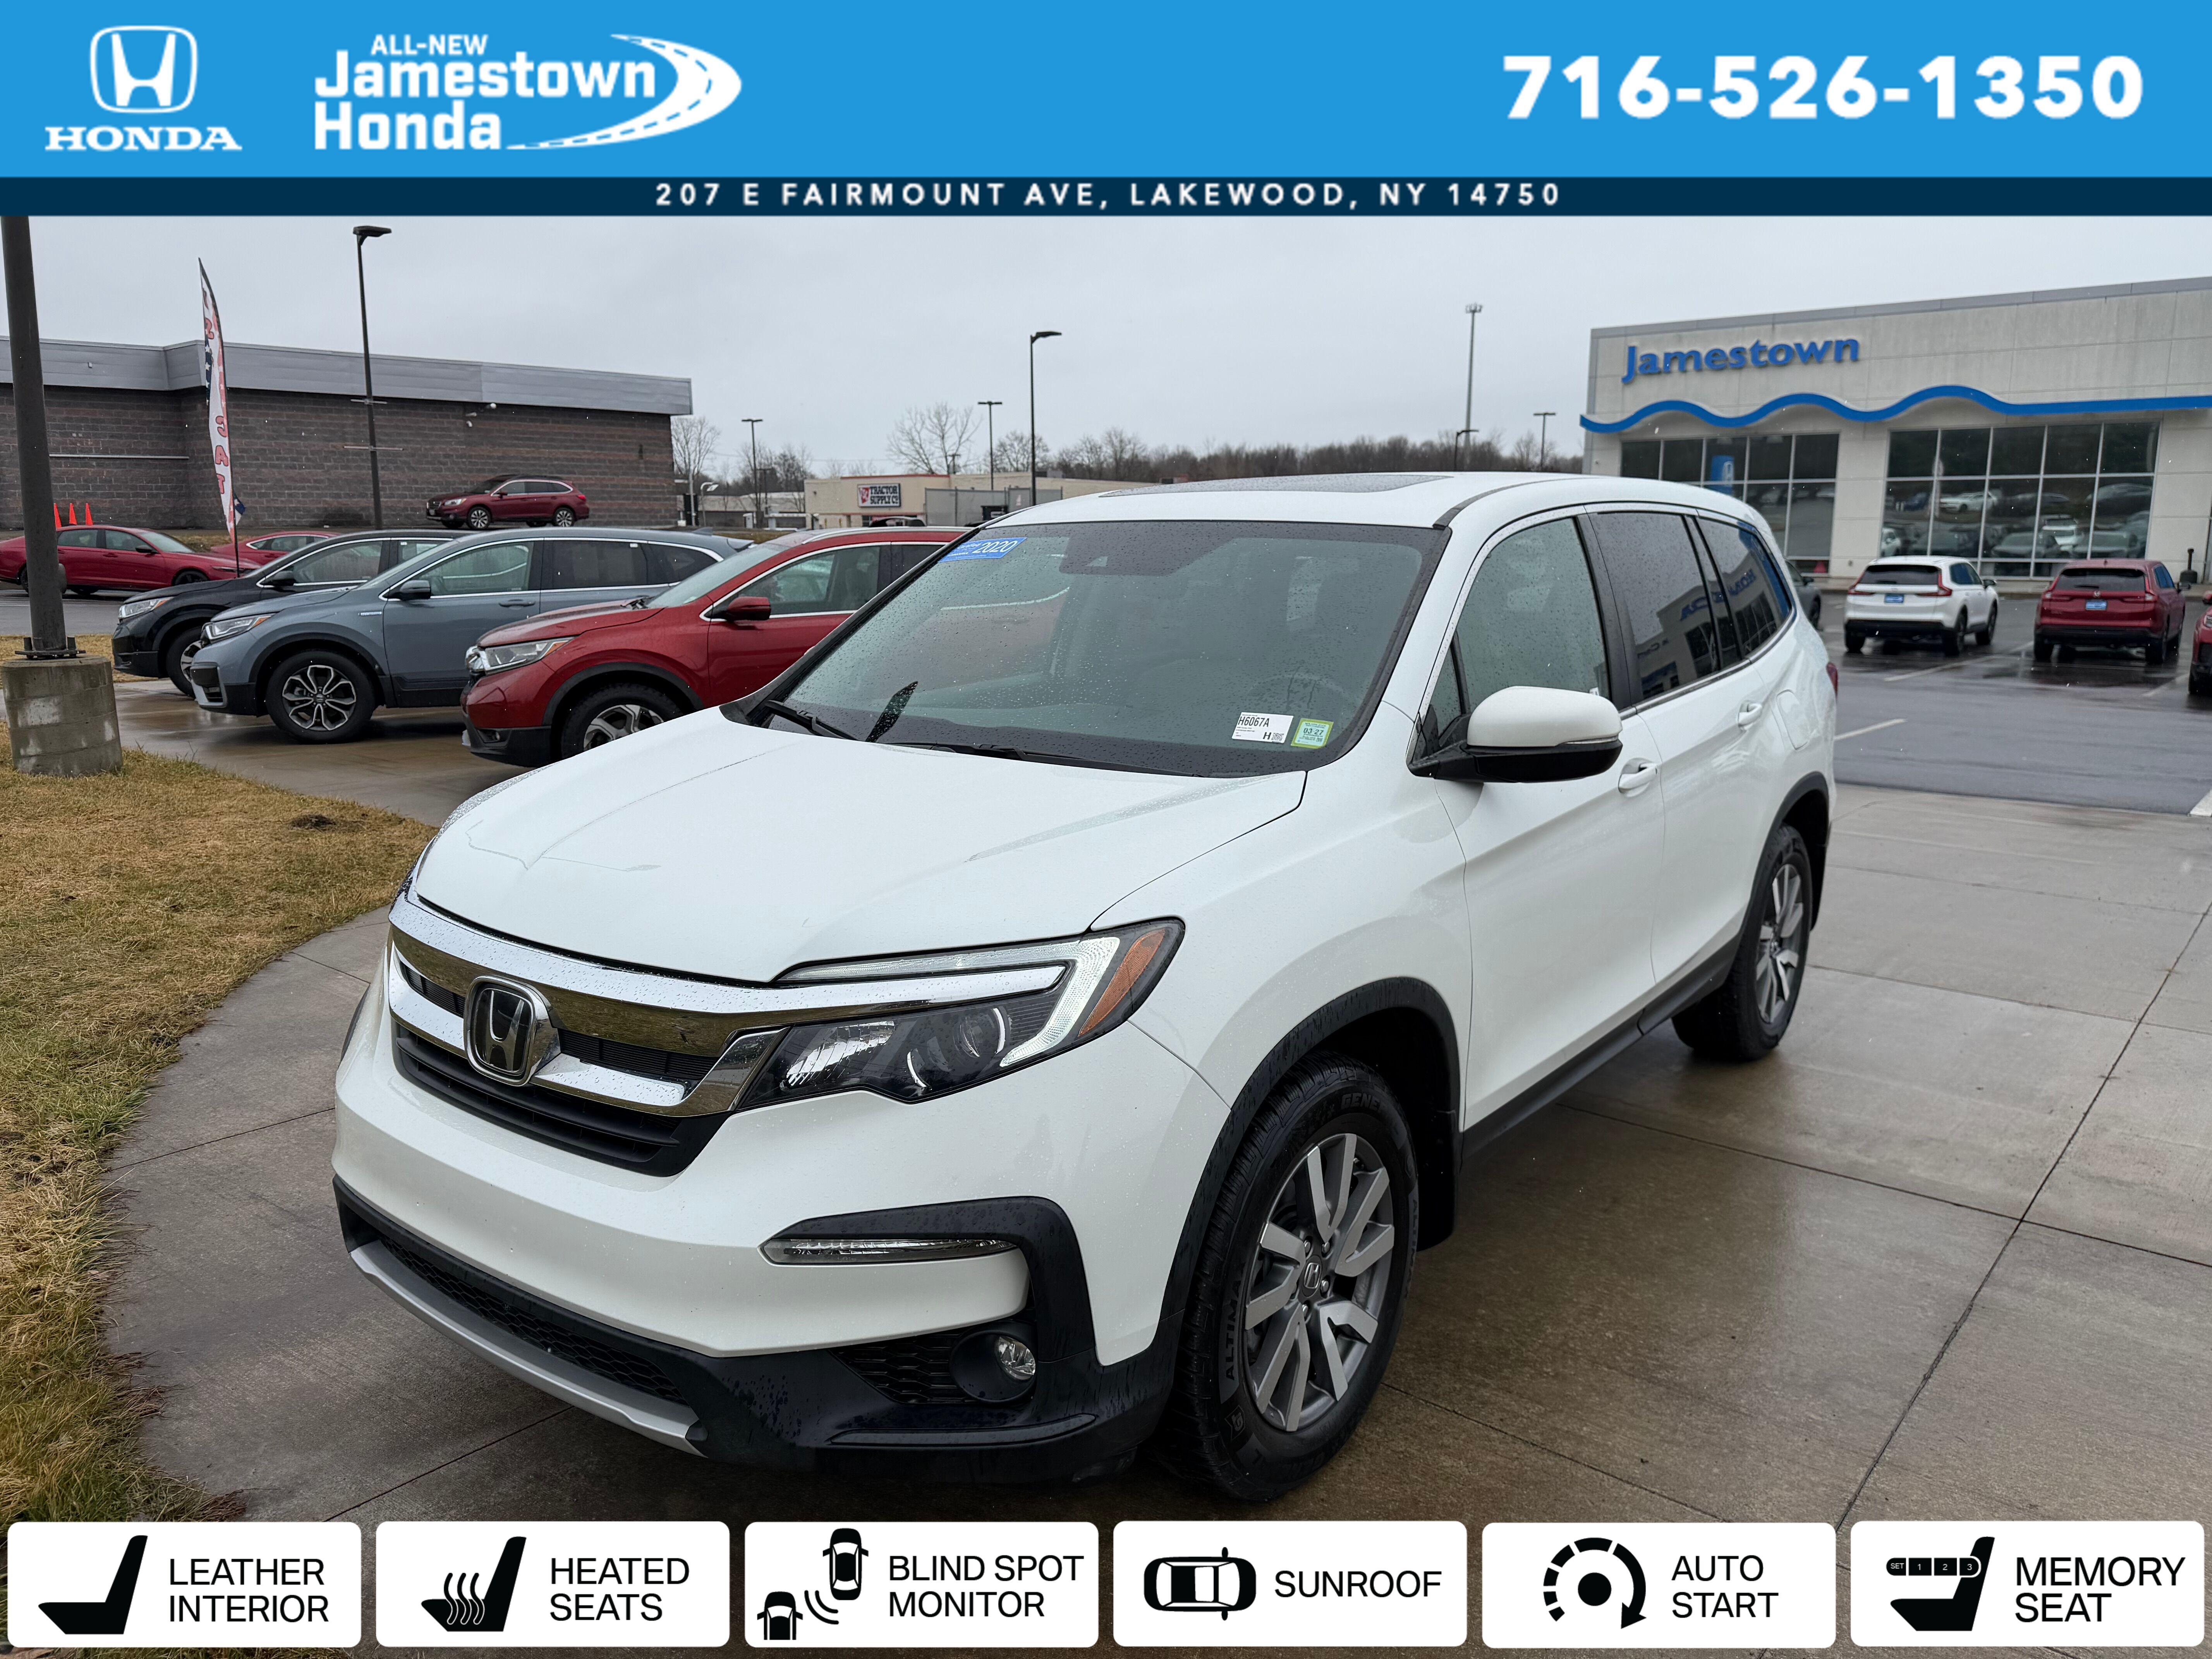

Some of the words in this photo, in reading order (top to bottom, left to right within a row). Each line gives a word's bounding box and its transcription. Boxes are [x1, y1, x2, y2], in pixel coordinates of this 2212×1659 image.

[1621, 339, 1860, 384] Jamestown
[870, 486, 897, 494] TRACTOR
[870, 496, 891, 504] SUPPLY
[972, 541, 1018, 554] 2020
[1238, 716, 1269, 727] H6067A
